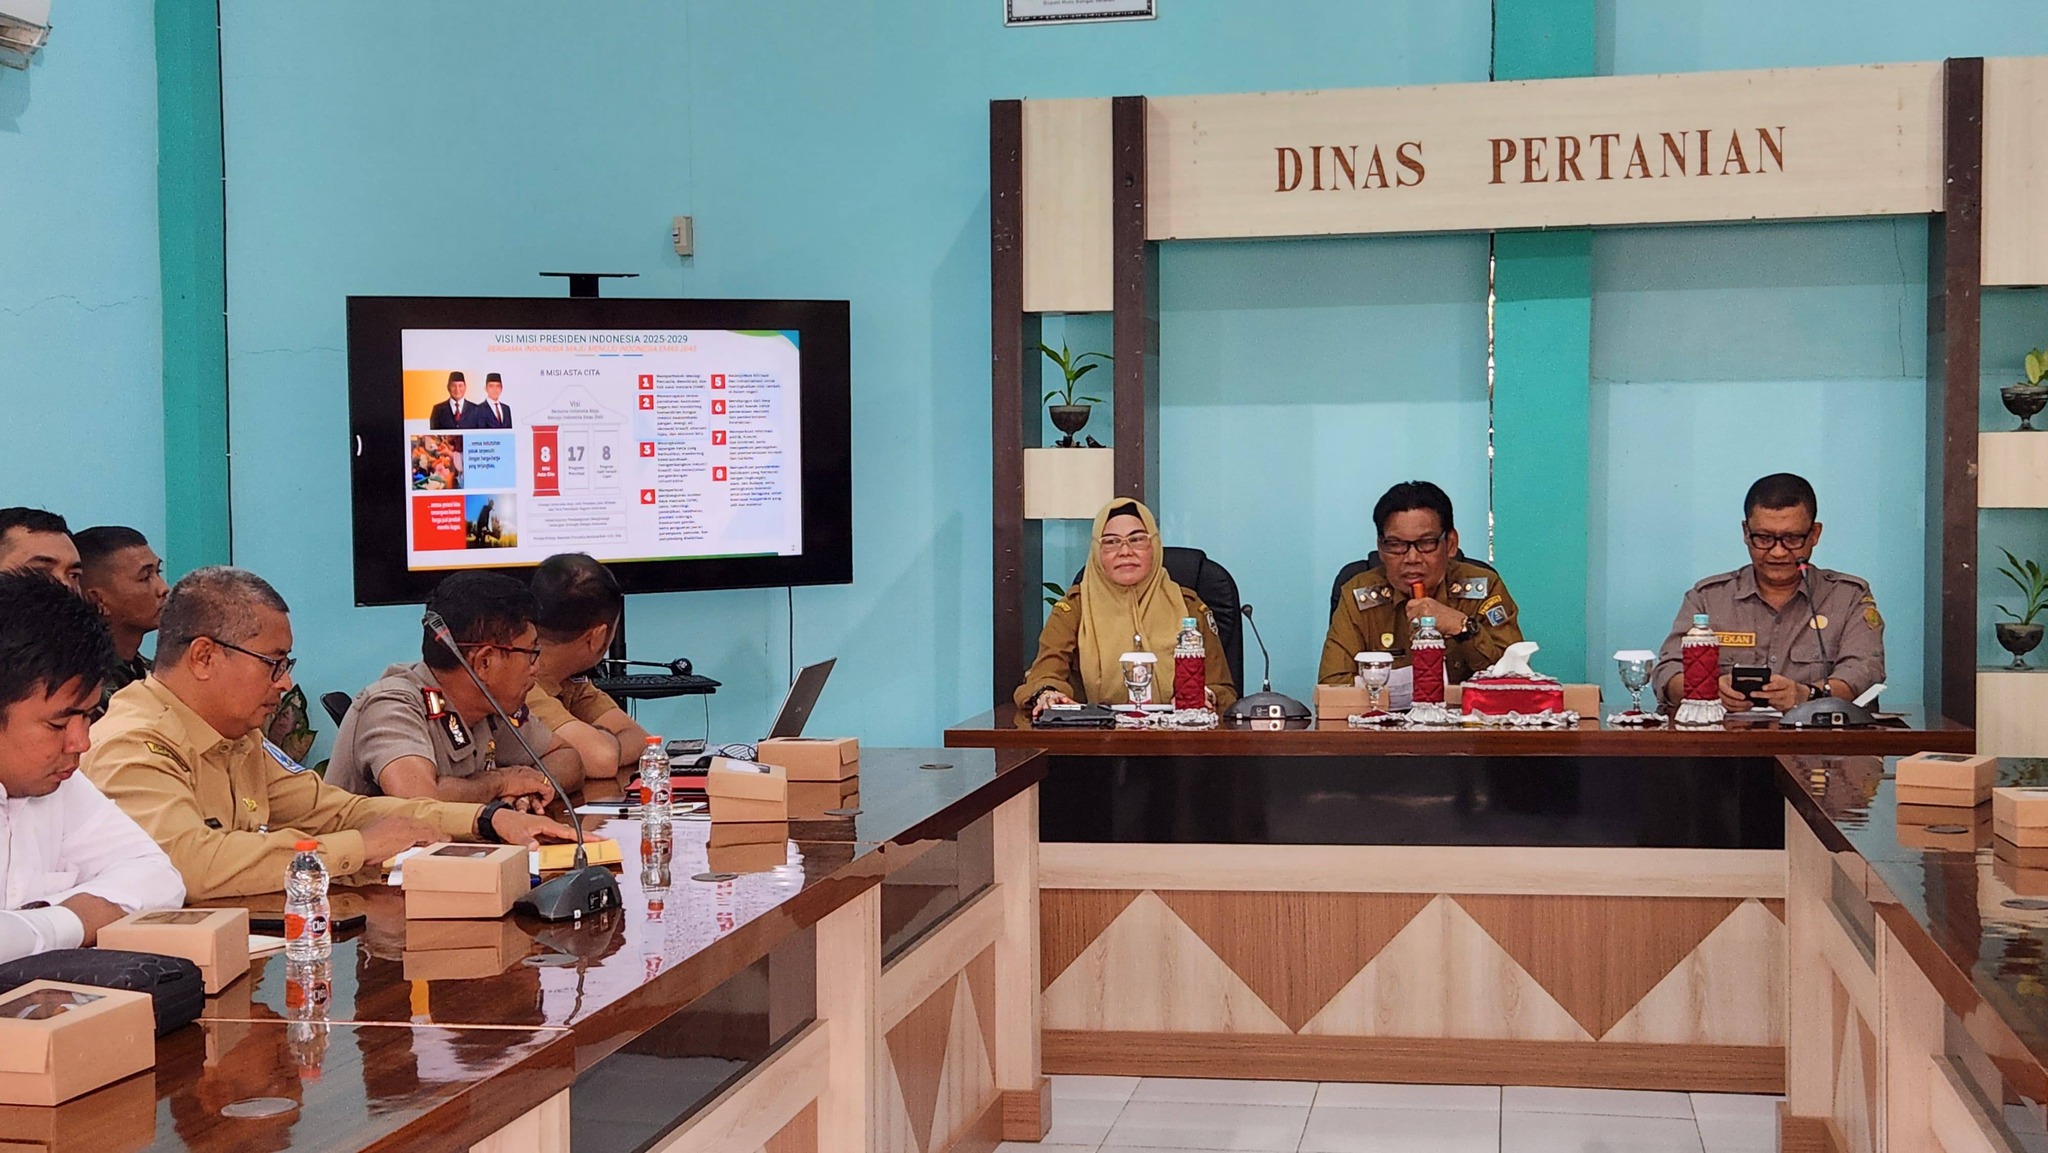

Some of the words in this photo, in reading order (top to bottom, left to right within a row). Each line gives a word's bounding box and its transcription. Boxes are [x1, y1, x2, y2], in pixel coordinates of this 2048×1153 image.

[1274, 141, 1425, 193] DINAS
[1488, 126, 1787, 185] PERTANIAN
[495, 334, 513, 343] VISI
[516, 334, 537, 343] MISI
[539, 334, 587, 343] PRESIDEN
[589, 334, 640, 343] INDONESIA
[643, 334, 688, 343] 2025-2029
[540, 446, 551, 463] 8
[567, 446, 585, 461] 17
[602, 445, 611, 461] 8
[312, 920, 327, 931] Cleo
